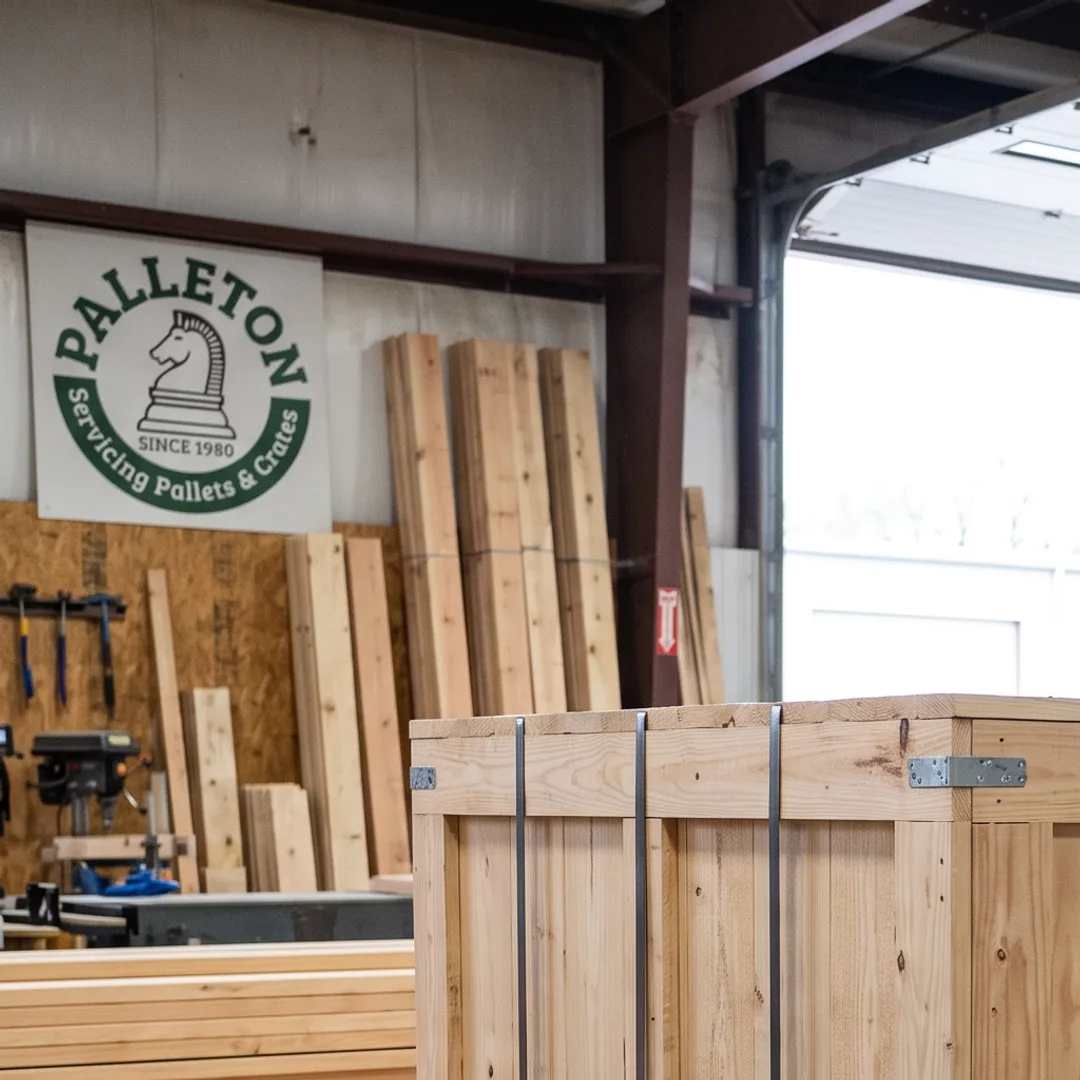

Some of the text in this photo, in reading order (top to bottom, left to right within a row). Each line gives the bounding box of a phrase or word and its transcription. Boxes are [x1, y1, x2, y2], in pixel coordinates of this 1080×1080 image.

[55, 256, 308, 387] PALLETON
[68, 386, 299, 502] Servicing Pallets & Crates
[138, 435, 235, 458] SINCE 1980
